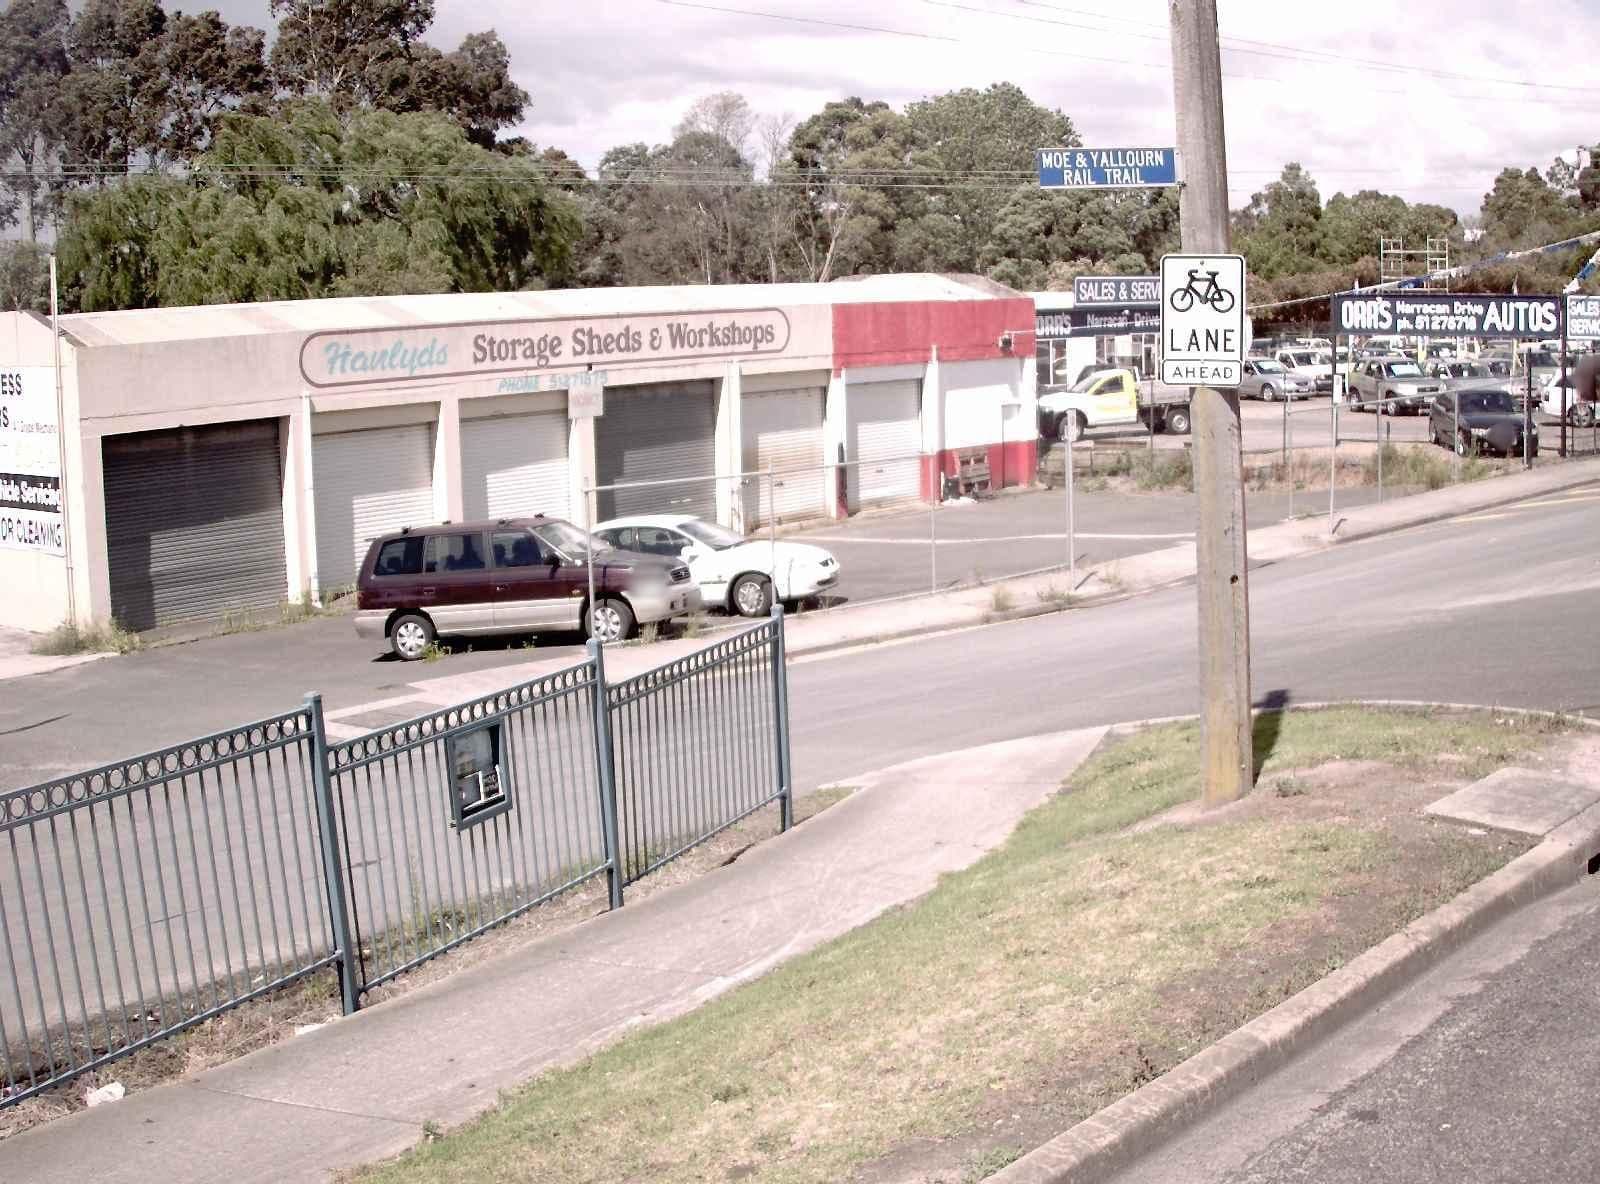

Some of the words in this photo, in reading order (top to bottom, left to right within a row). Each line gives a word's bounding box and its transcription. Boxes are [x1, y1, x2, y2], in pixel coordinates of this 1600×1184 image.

[1041, 151, 1071, 169] MOE
[1075, 152, 1088, 169] &
[1090, 150, 1164, 168] YALLOURN
[1063, 168, 1096, 185] RAIL
[1103, 167, 1145, 185] TRAIL
[1079, 282, 1116, 301] SALES
[1118, 282, 1129, 300] &
[1395, 301, 1450, 315] Narracan
[1453, 301, 1484, 316] Drive
[1483, 301, 1557, 332] AUTOS
[1570, 301, 1600, 316] SALES
[472, 333, 563, 368] Storage
[572, 325, 642, 357] Sheds
[649, 327, 662, 351] &
[667, 319, 775, 351] Workshops
[1170, 328, 1235, 353] LANE
[1172, 366, 1233, 379] AHEAD
[17, 518, 62, 548] CLEANING
